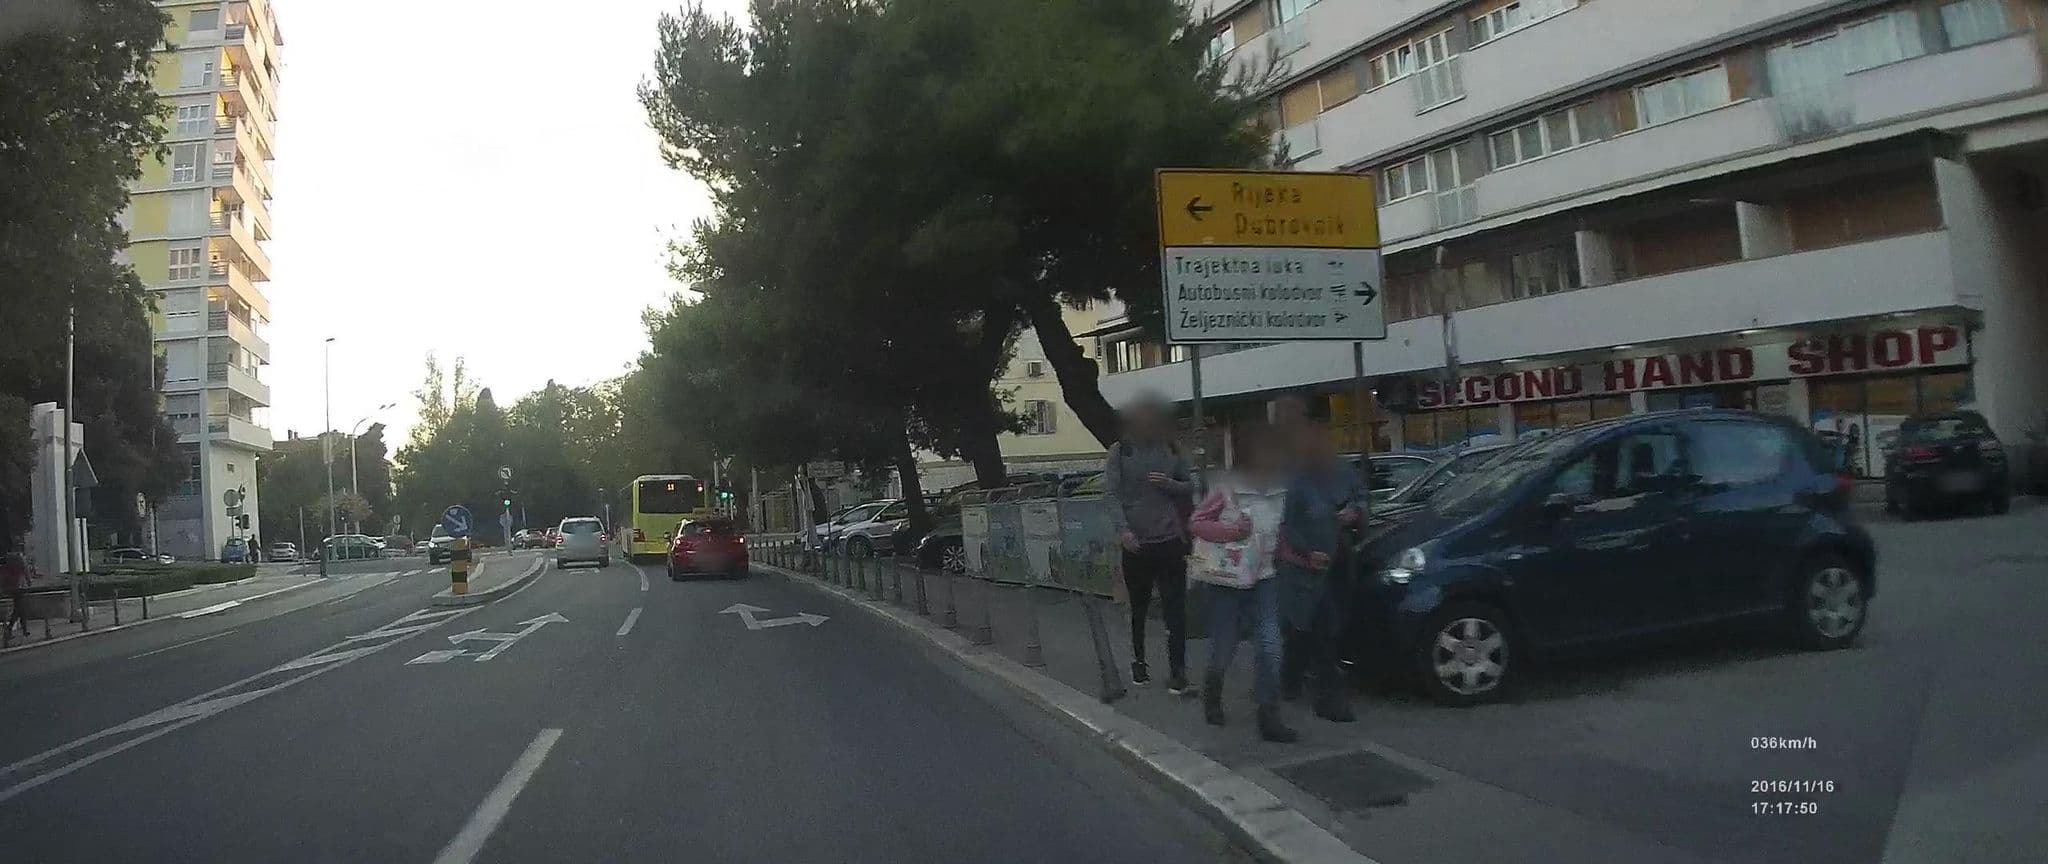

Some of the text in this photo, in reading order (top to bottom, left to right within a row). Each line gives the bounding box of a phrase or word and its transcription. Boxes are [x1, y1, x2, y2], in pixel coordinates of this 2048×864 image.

[1235, 212, 1344, 236] Dubrovnik
[1175, 256, 1304, 278] Trajektna luka
[1178, 283, 1323, 302] Autobusni kolodvor
[1266, 311, 1328, 329] kolodvor
[1417, 326, 1959, 408] SECOND HAND SHOP
